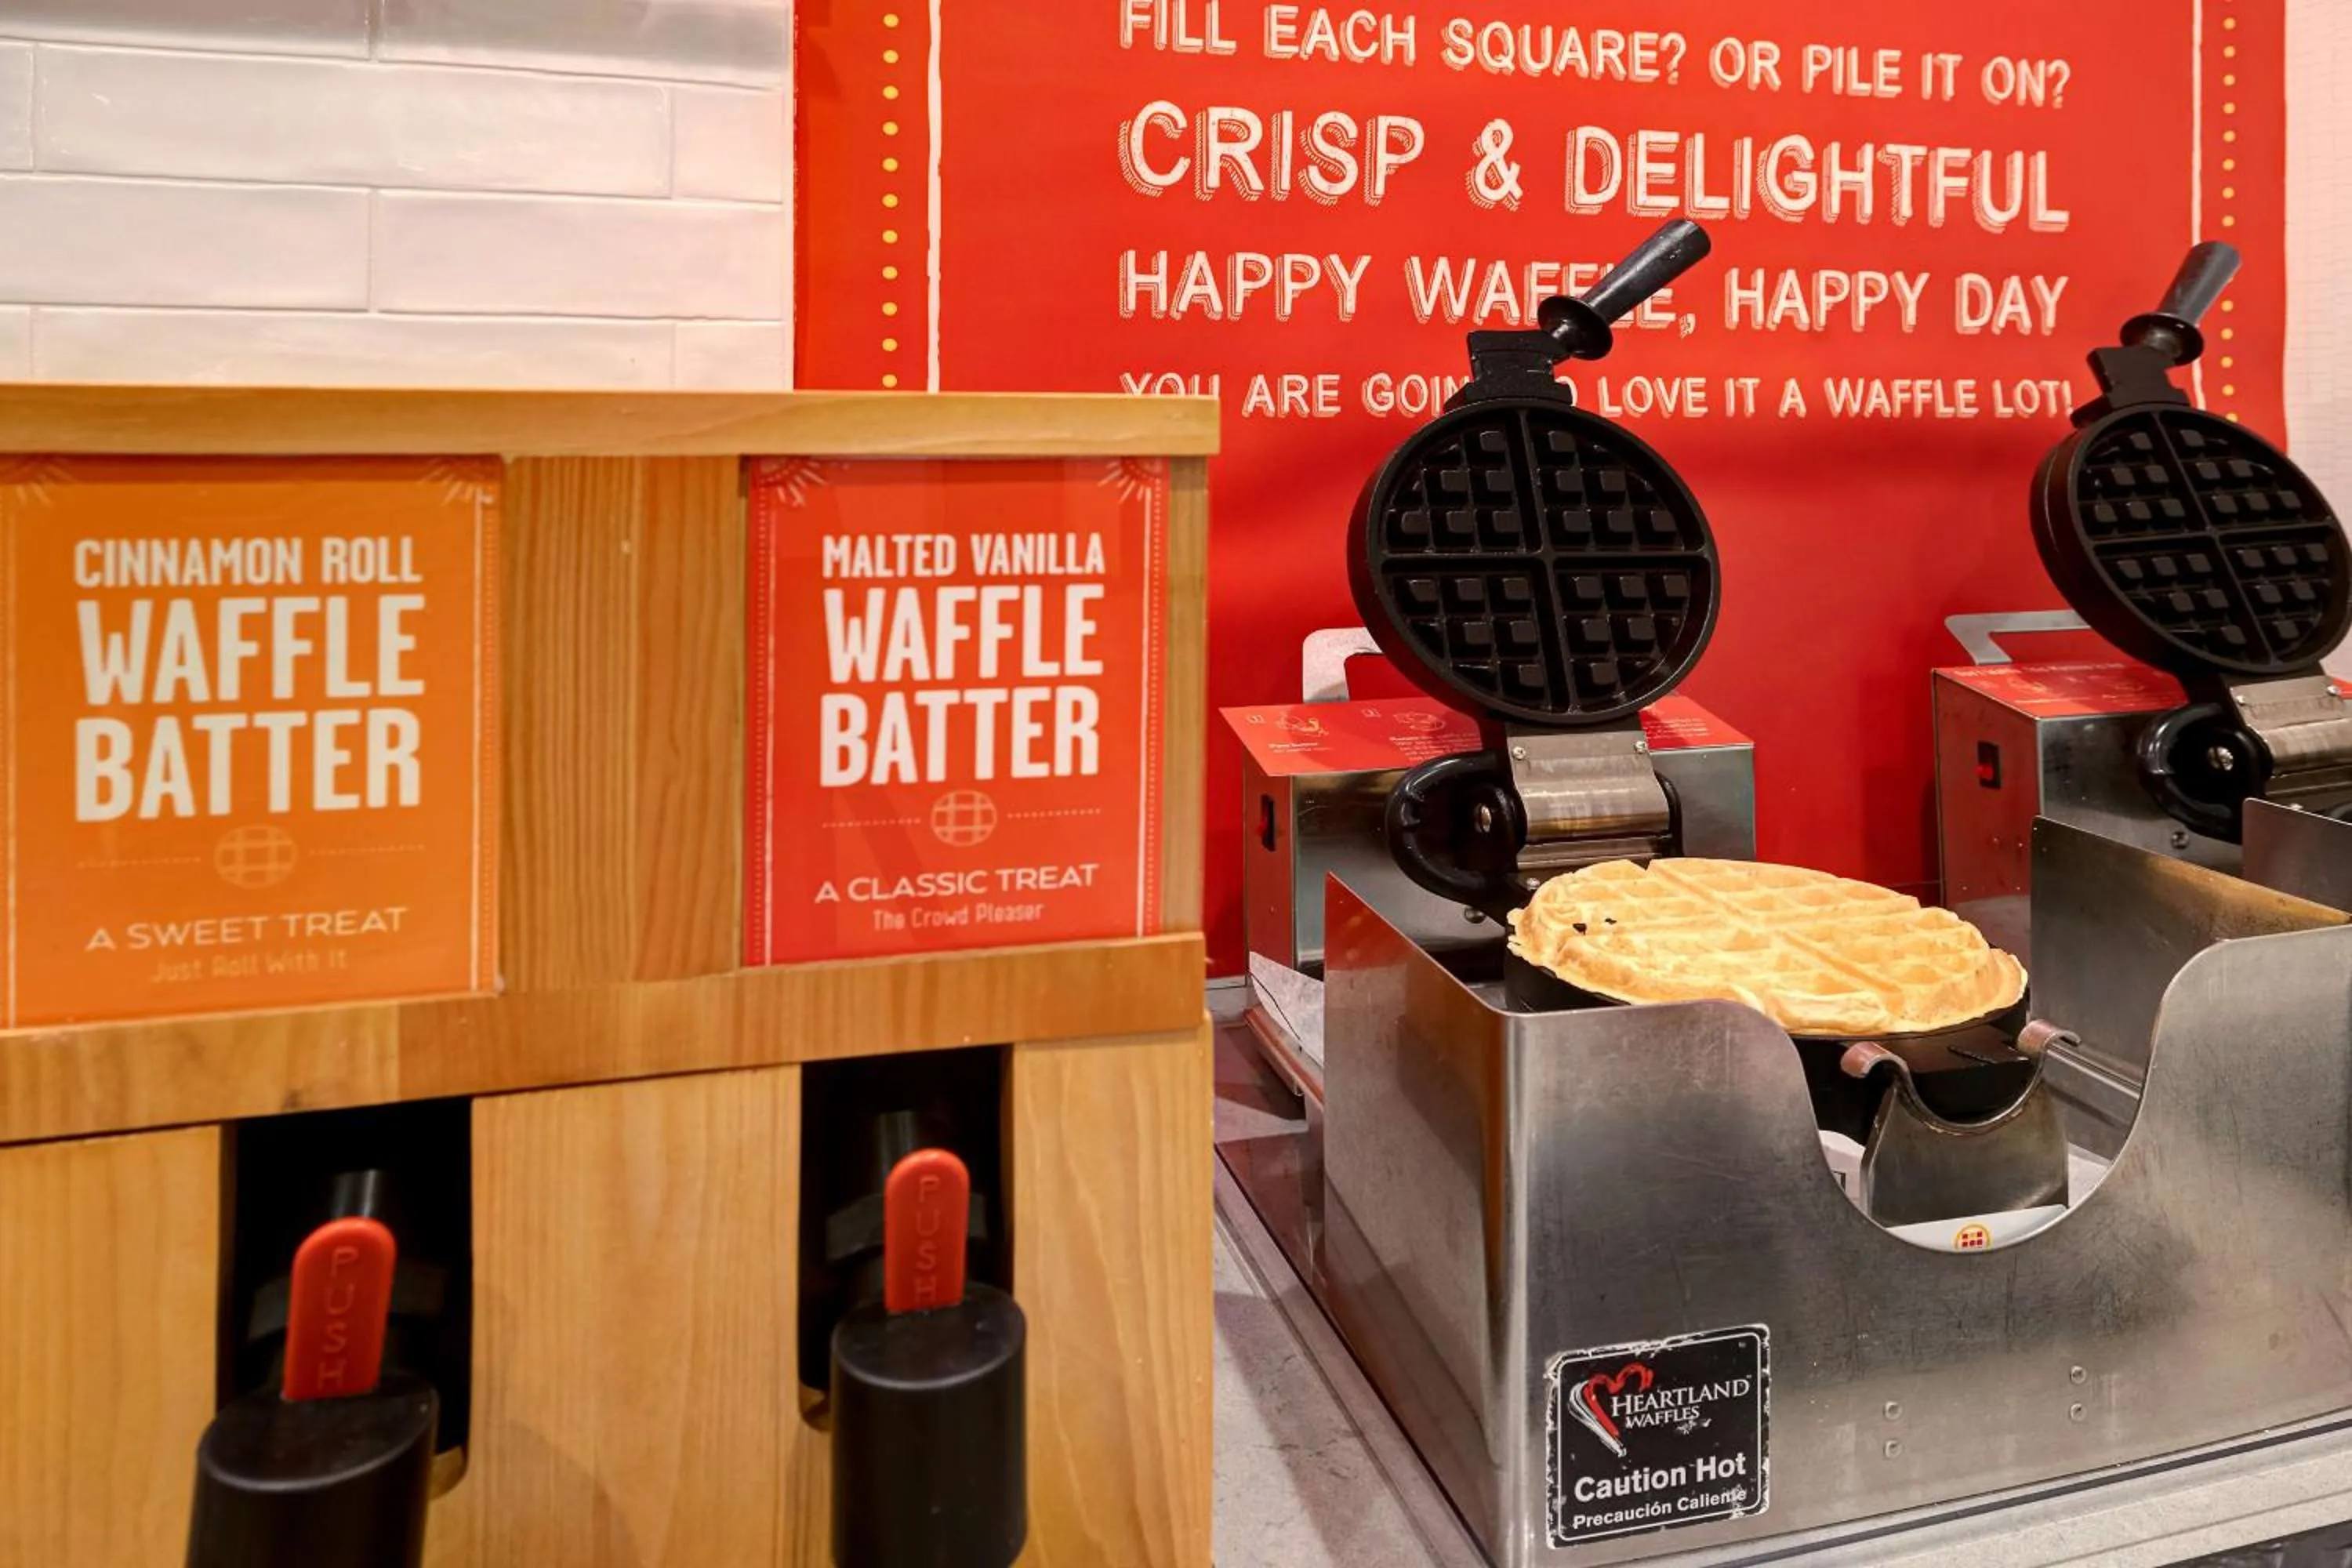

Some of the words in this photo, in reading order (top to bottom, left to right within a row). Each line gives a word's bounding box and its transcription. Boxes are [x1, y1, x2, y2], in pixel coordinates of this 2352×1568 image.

[1120, 0, 1237, 55] FILL
[1264, 4, 1416, 66] EACH
[1441, 18, 1686, 84] SQUARE?
[1709, 36, 1781, 91] OR
[1802, 44, 1902, 98] PILE
[1921, 53, 1962, 101] IT
[1980, 56, 2071, 108] ON?
[1118, 100, 1425, 208] CRISP
[1466, 118, 1523, 211] &
[1565, 126, 2070, 233] DELIGHTFUL
[1119, 250, 1371, 322] HAPPY
[1405, 256, 1697, 339] WAFFE,
[1725, 267, 1929, 332] HAPPY
[1955, 273, 2068, 335] DAY
[1241, 374, 1341, 418] ARE
[1598, 376, 1708, 418] LOVE
[1725, 377, 1759, 418] IT
[1778, 378, 1806, 418] A
[1824, 377, 1980, 418] WAFFLE
[1993, 379, 2074, 418] LOT!
[74, 537, 303, 588] CINNAMON
[321, 535, 423, 584] ROLL
[822, 533, 956, 579] MALTED
[971, 532, 1105, 576] VANILLA
[77, 594, 426, 706] WAFFLE
[823, 584, 1104, 684] WAFFLE
[820, 685, 1099, 787] BATTER
[75, 708, 422, 823] BATTER
[815, 880, 840, 904] A
[847, 870, 989, 902] CLASSIC
[995, 863, 1100, 892] TREAT
[85, 927, 118, 952] A
[126, 916, 269, 950] SWEET
[281, 906, 409, 938] TREAT
[873, 909, 905, 931] The
[912, 905, 970, 929] Crowd
[975, 902, 1045, 924] Pleaser
[151, 958, 203, 983] Just
[212, 953, 260, 978] Roll
[265, 949, 318, 975] With
[329, 949, 348, 970] It
[317, 1245, 359, 1392] PUSH
[1611, 1378, 1751, 1417] HEARTLAND
[1625, 1405, 1700, 1429] WAFFLES
[1574, 1465, 1686, 1503] Caution
[1697, 1453, 1747, 1482] Hot
[1573, 1501, 1672, 1529] Precaución
[1677, 1487, 1747, 1512] Caliente
